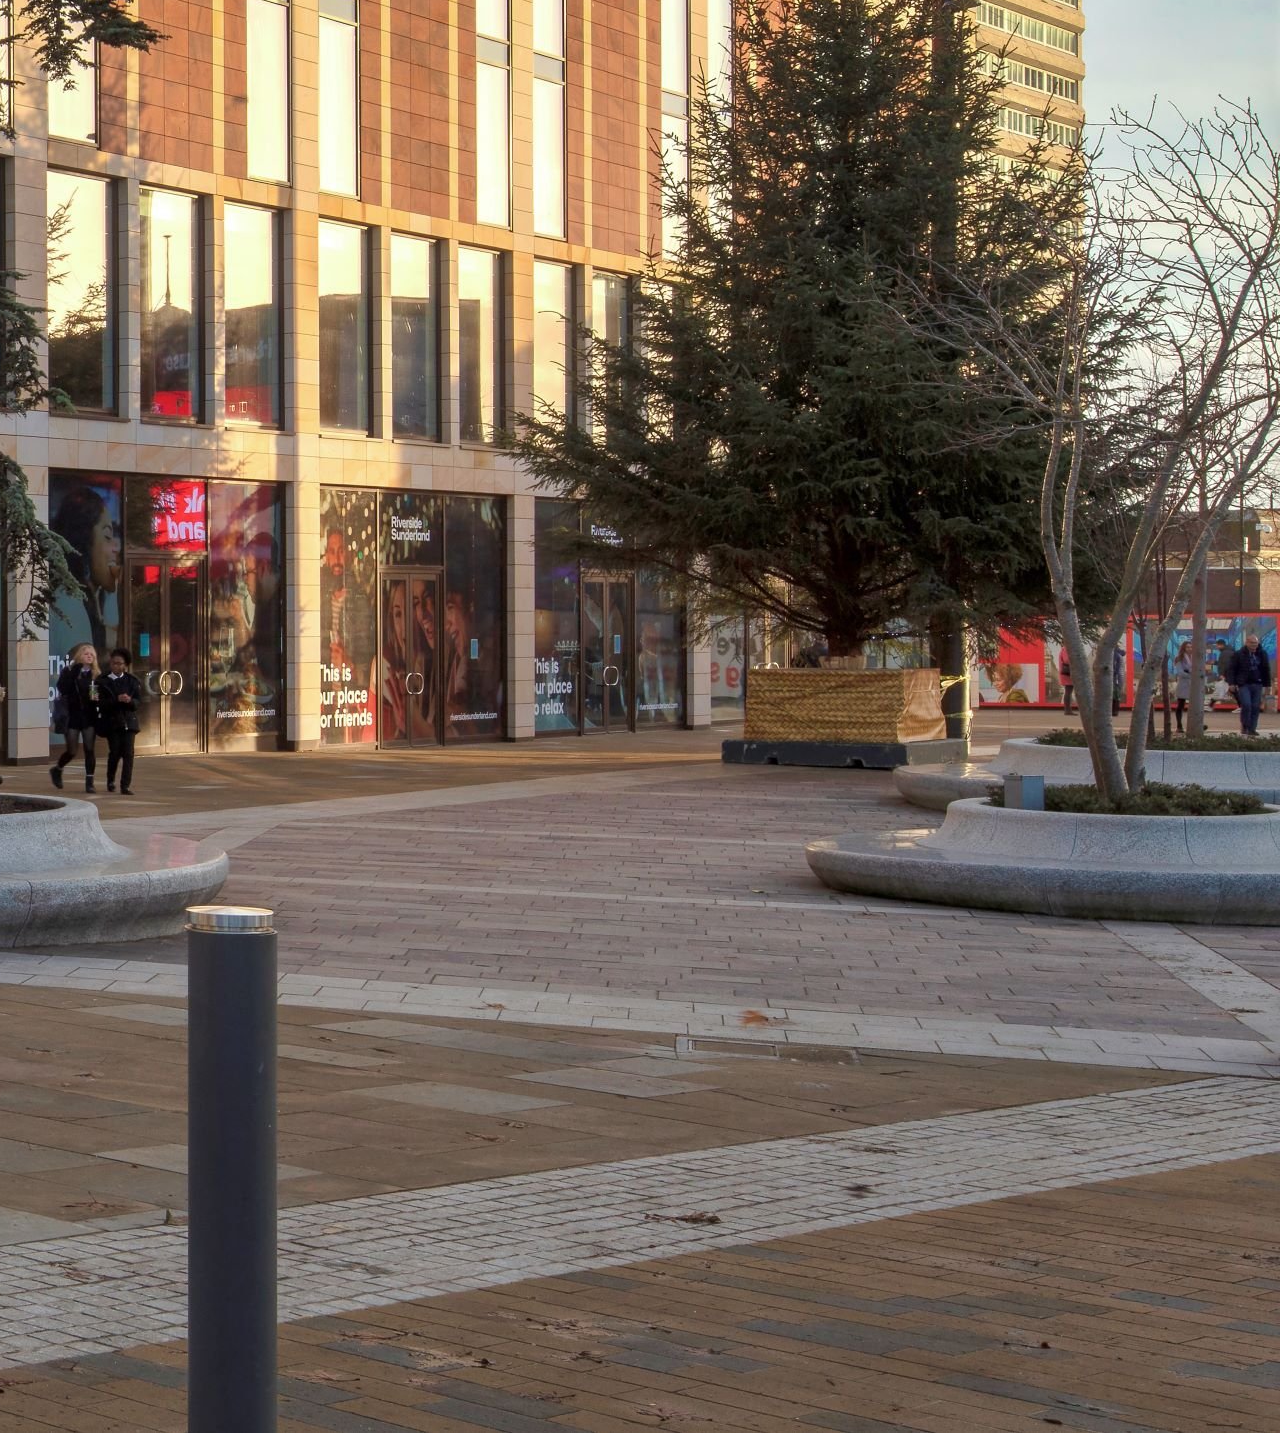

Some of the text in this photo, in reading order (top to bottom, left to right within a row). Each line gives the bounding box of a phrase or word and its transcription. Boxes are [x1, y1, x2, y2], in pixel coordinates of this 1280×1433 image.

[391, 515, 423, 529] Riverside
[391, 528, 431, 542] Sunderland
[342, 662, 352, 682] is
[534, 656, 560, 674] his is
[337, 685, 368, 709] place
[535, 677, 573, 698] ur place
[541, 698, 564, 715] relax
[334, 708, 373, 728] friends
